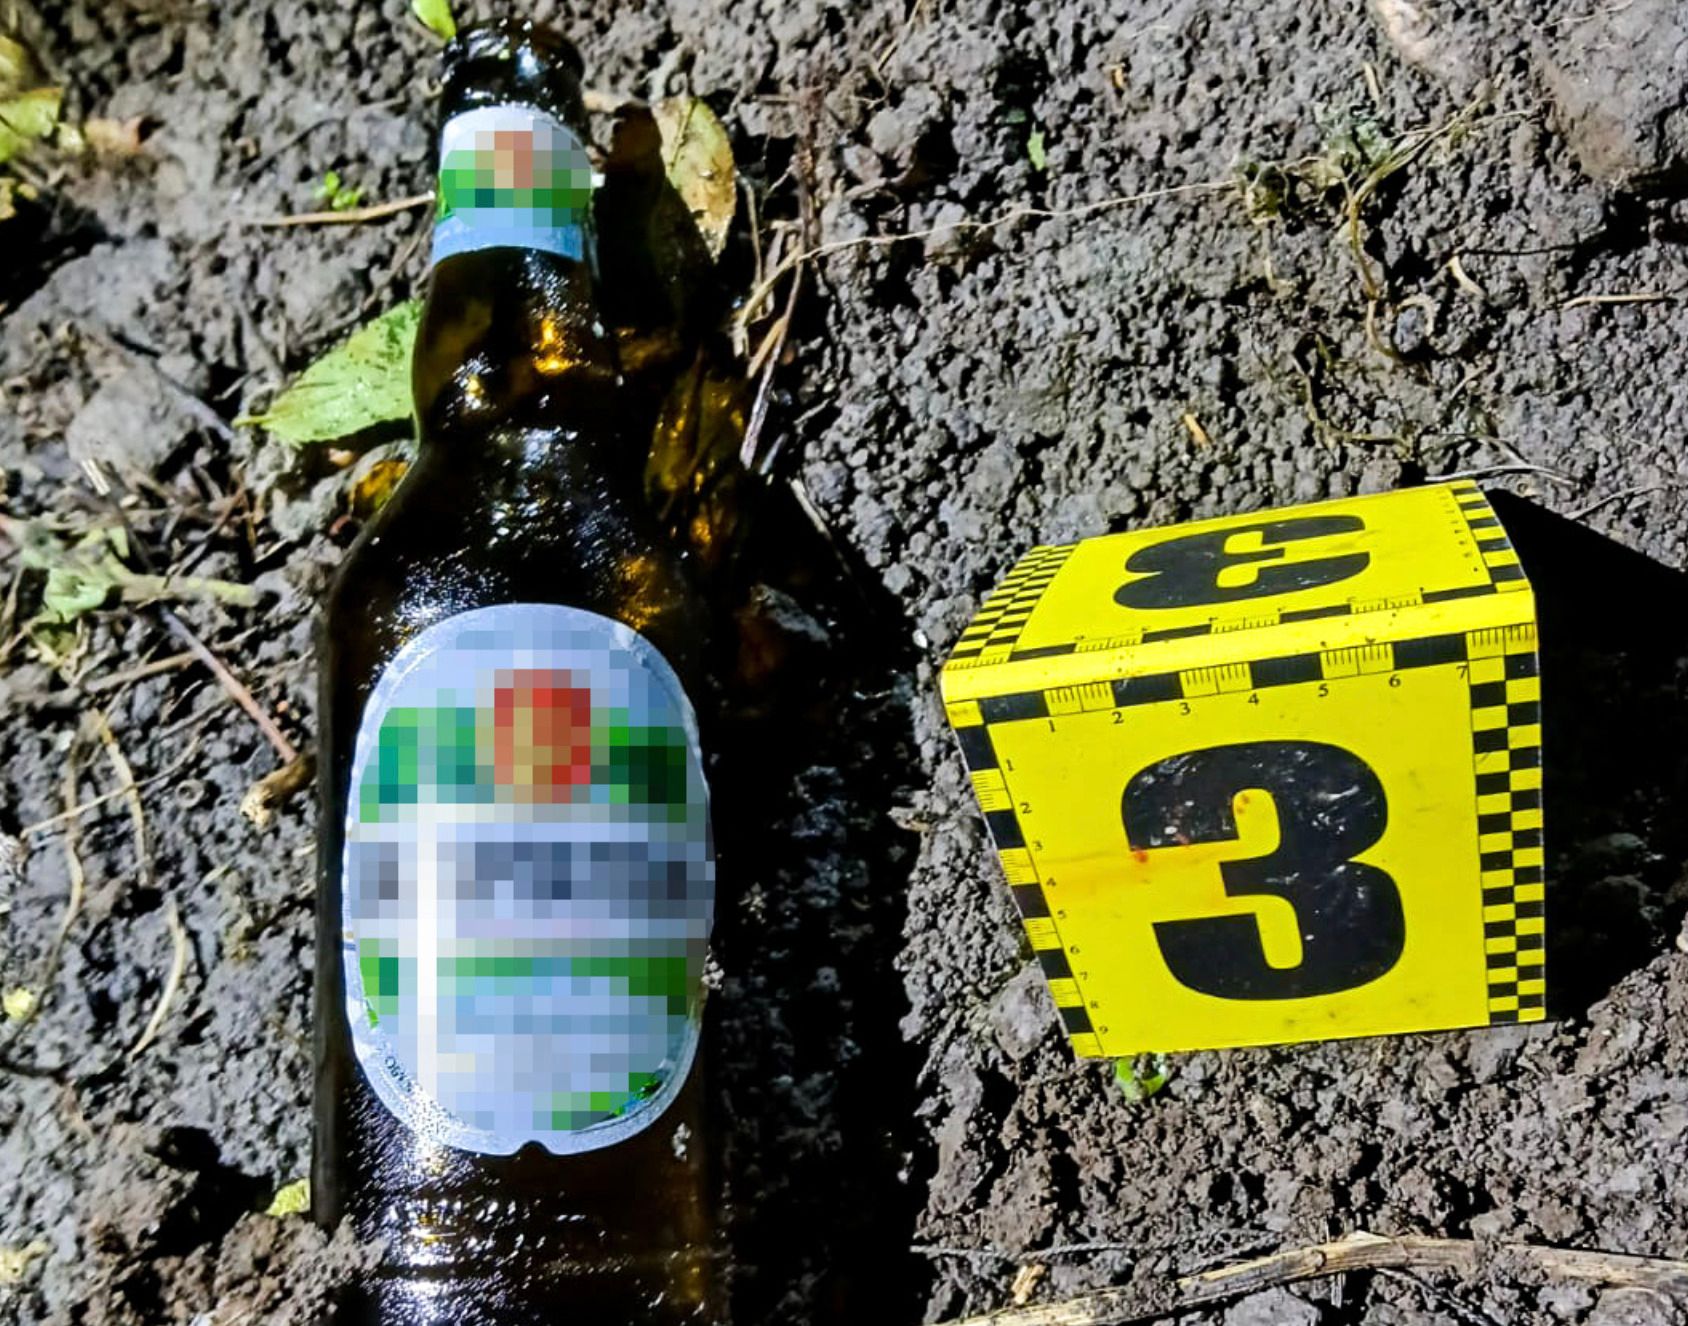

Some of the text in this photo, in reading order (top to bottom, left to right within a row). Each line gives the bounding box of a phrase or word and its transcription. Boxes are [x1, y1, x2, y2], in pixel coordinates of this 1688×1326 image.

[1113, 515, 1370, 610] 3
[1048, 665, 1468, 733] 1 2 3 4 5 6 7
[1005, 759, 1014, 772] 1
[1020, 802, 1032, 814] 2
[1034, 840, 1043, 852] 3
[1121, 739, 1406, 1001] 3
[1046, 877, 1057, 887] 4
[1057, 909, 1067, 920] 5
[1069, 945, 1080, 955] 6
[1079, 971, 1089, 981] 7
[1090, 1001, 1100, 1009] 8
[1099, 1025, 1109, 1035] 9
